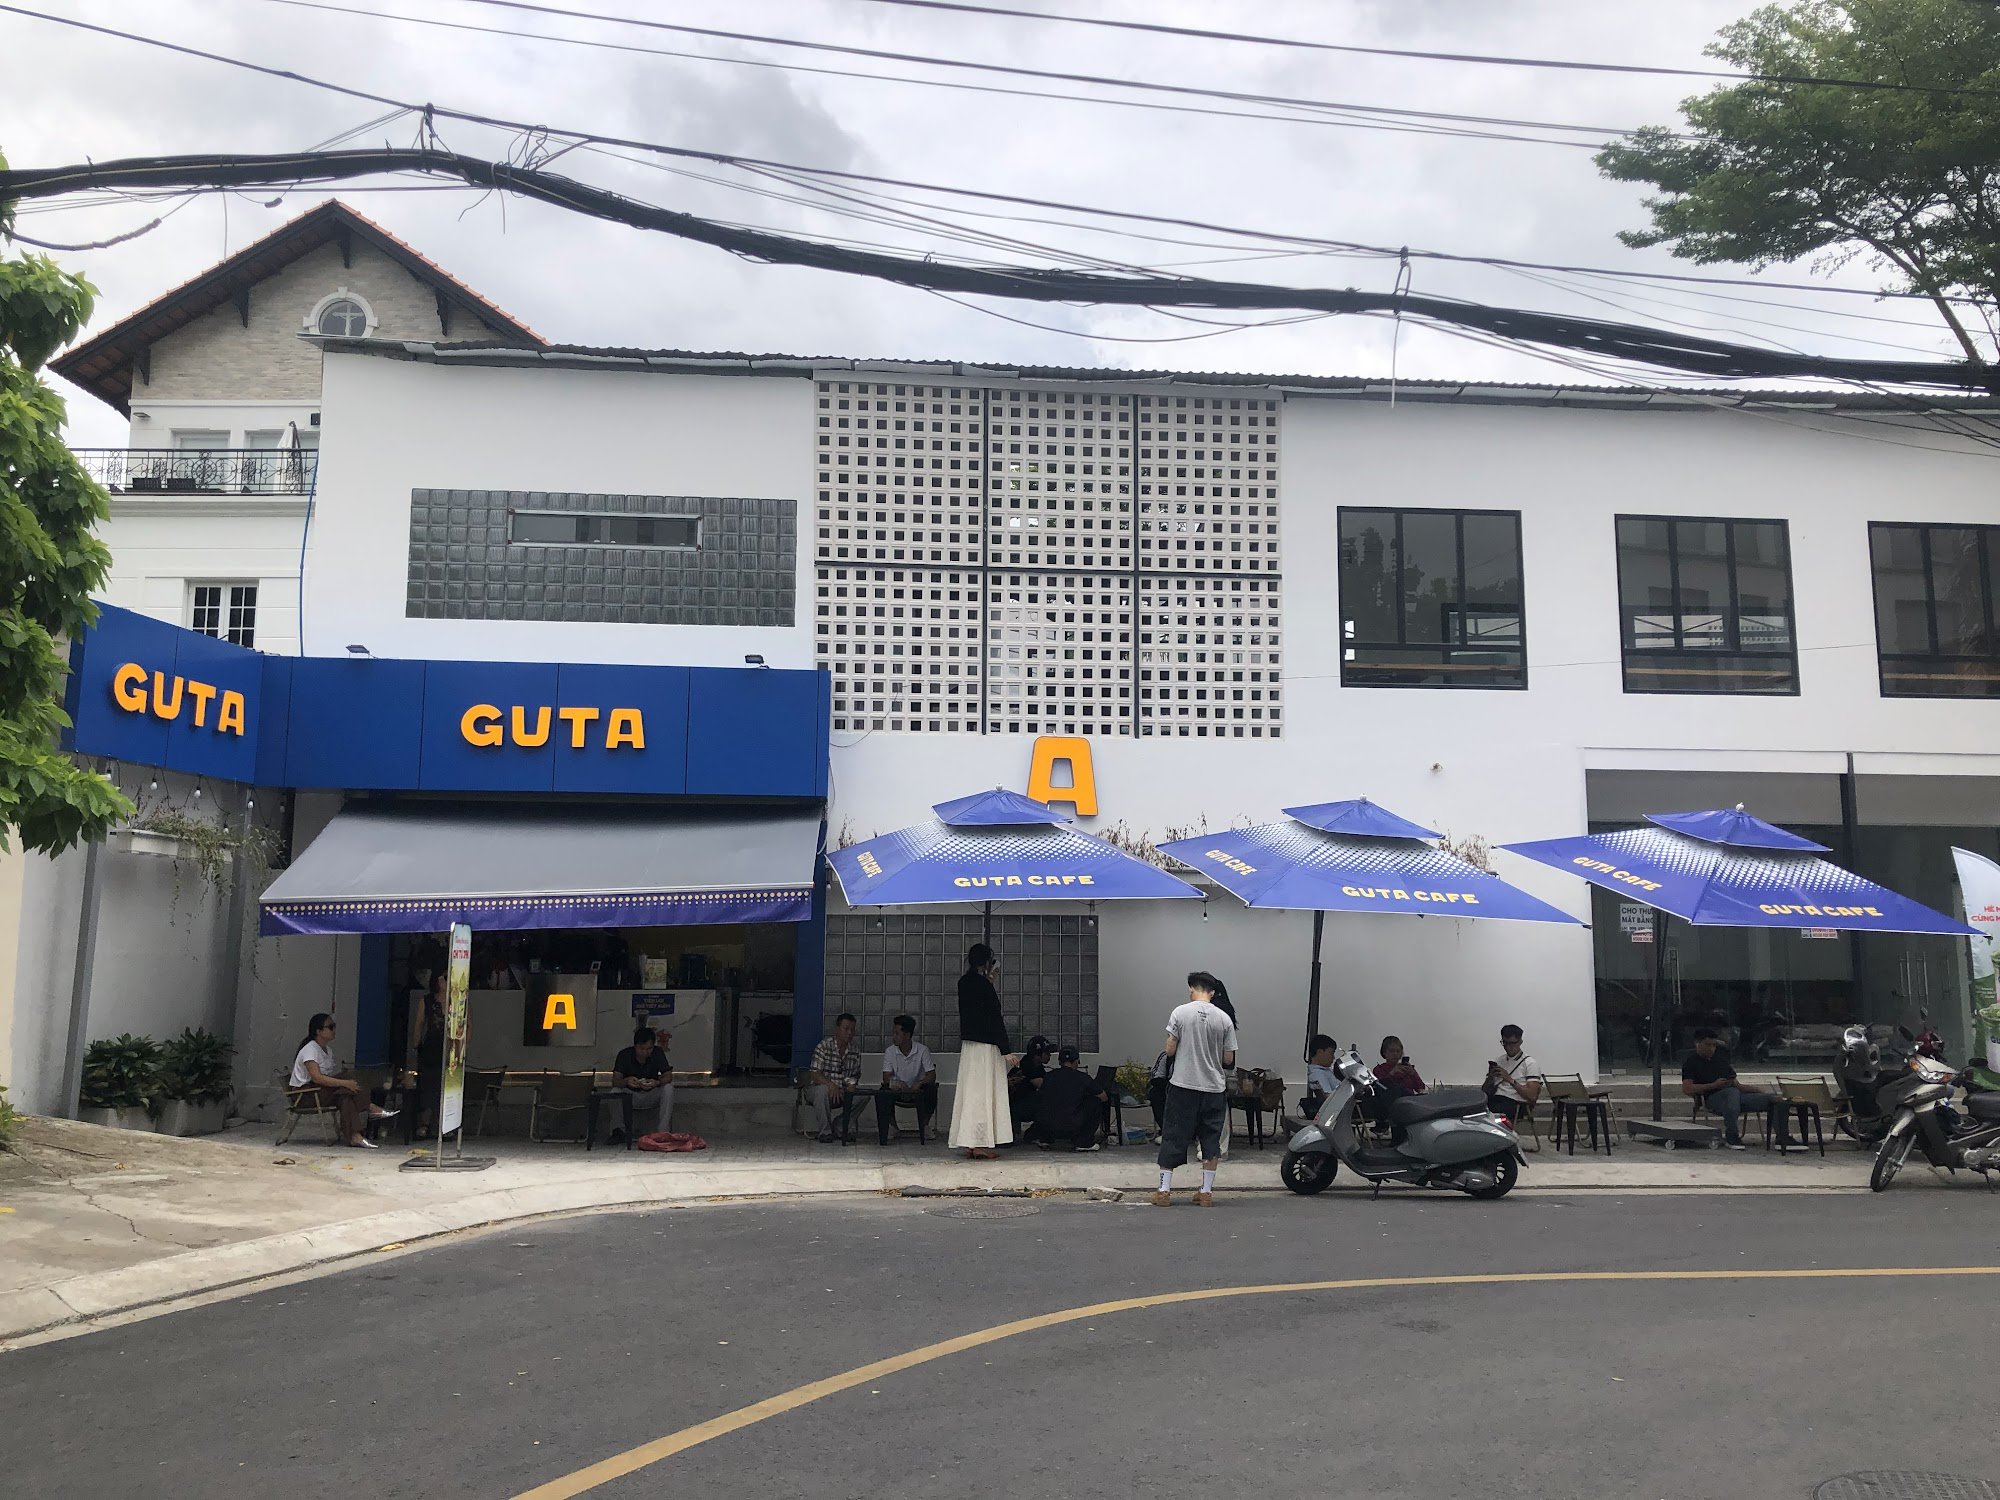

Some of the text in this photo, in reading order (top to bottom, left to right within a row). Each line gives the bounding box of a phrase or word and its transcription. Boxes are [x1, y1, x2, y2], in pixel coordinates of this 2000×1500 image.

[113, 662, 245, 737] GUTA
[460, 704, 646, 750] GUTA
[1027, 736, 1098, 816] A
[857, 851, 883, 878] GUTA CAFE
[1205, 850, 1258, 876] GUTA CAFE
[1573, 857, 1663, 892] GUTA CAFE
[953, 875, 1095, 887] GUTA CAFE
[1342, 886, 1480, 904] GUTA CAFE
[1759, 904, 1884, 917] GUTA CAFE
[542, 993, 577, 1030] A
